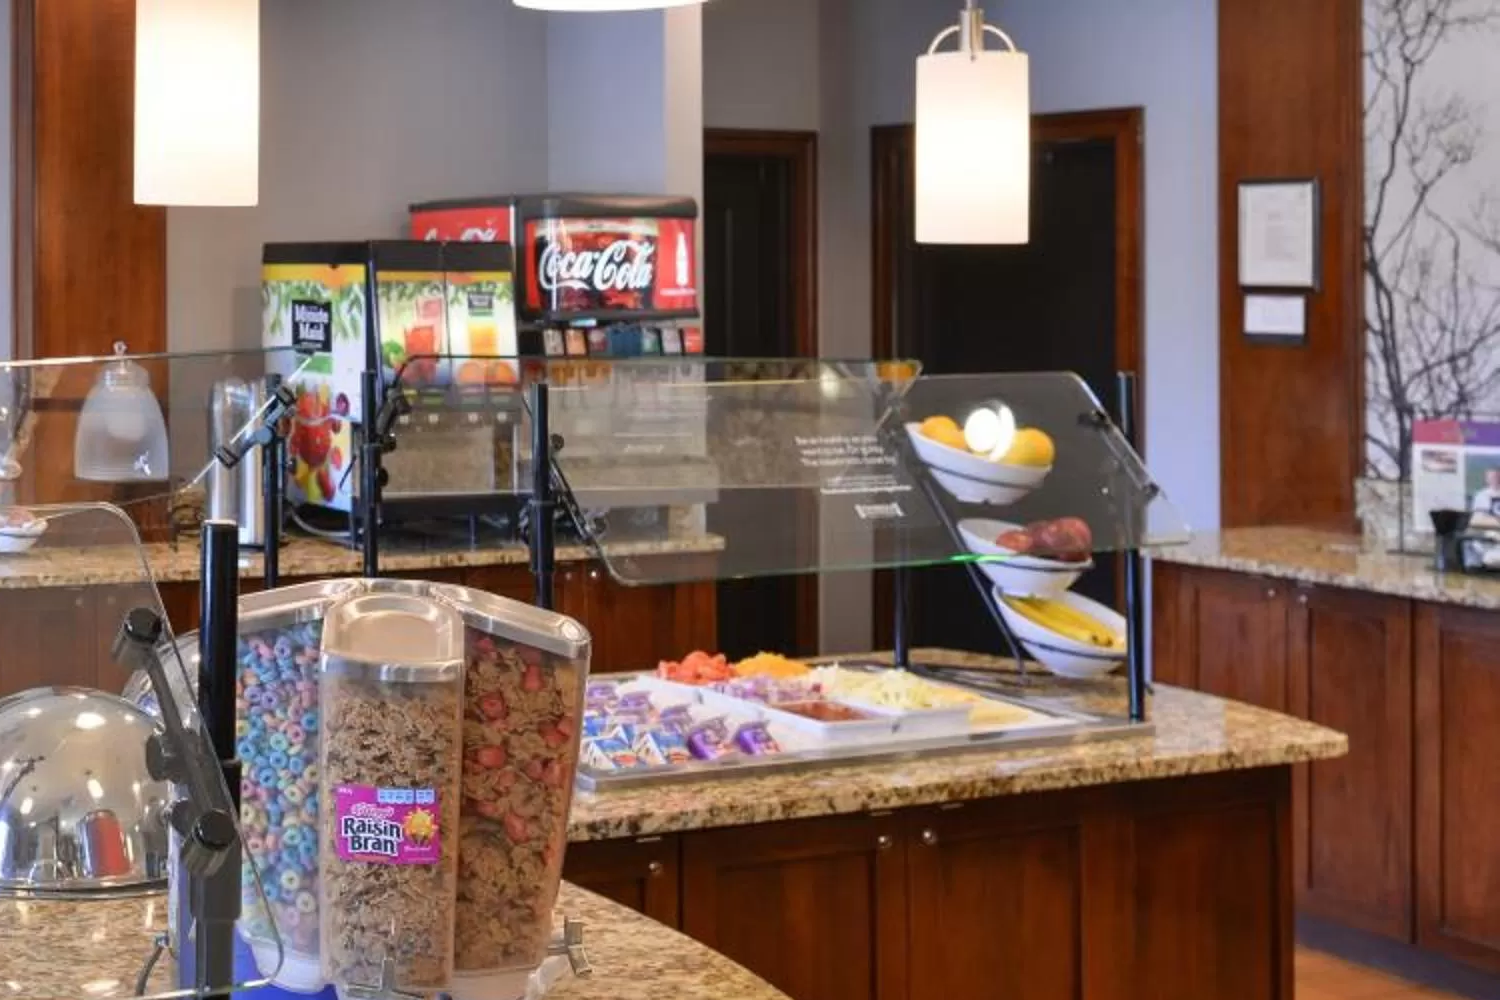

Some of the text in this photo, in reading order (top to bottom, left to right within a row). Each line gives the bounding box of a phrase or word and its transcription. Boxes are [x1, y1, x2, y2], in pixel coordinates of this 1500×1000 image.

[539, 239, 654, 291] Coca-Cola
[298, 322, 325, 341] Maid
[343, 816, 402, 840] Raisin
[349, 835, 397, 855] Bran
